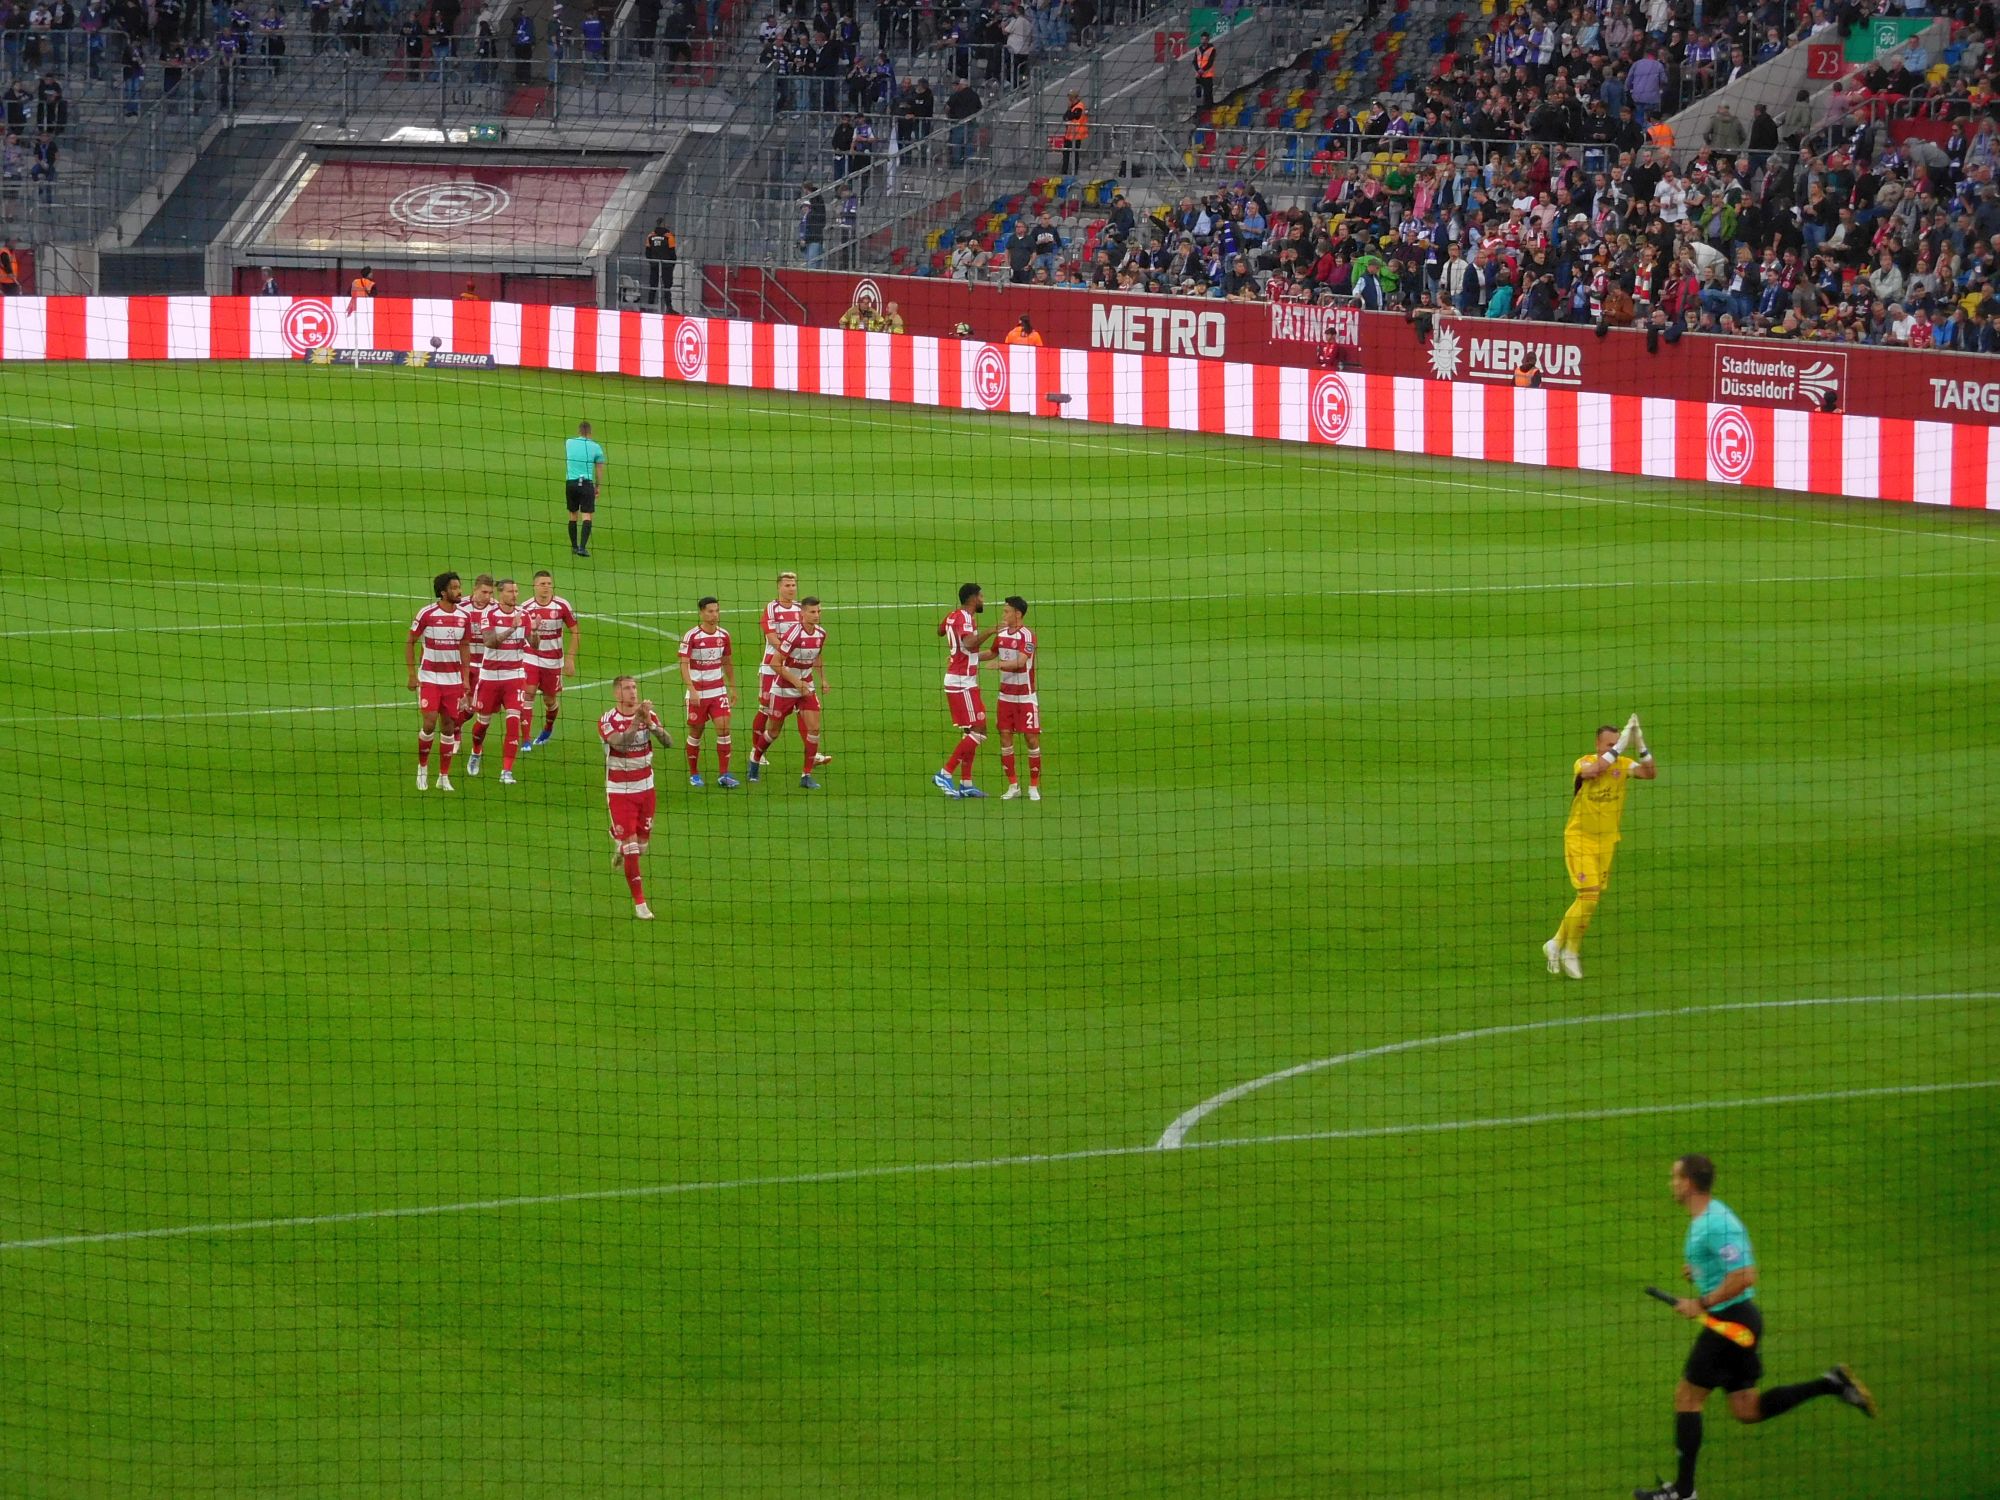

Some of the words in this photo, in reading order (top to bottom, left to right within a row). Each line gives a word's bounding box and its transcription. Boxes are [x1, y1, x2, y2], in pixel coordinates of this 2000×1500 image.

[1817, 51, 1839, 74] 23
[1091, 303, 1226, 358] METRO
[1271, 303, 1360, 346] RATINGEN
[340, 349, 395, 361] MERKUR
[434, 353, 488, 365] MERKUR
[1468, 337, 1582, 377] MERKUR
[1721, 356, 1796, 378] Stadtwerke
[1720, 377, 1796, 400] Düsseldorf
[1929, 378, 2000, 413] TARG
[1026, 711, 1034, 724] 2
